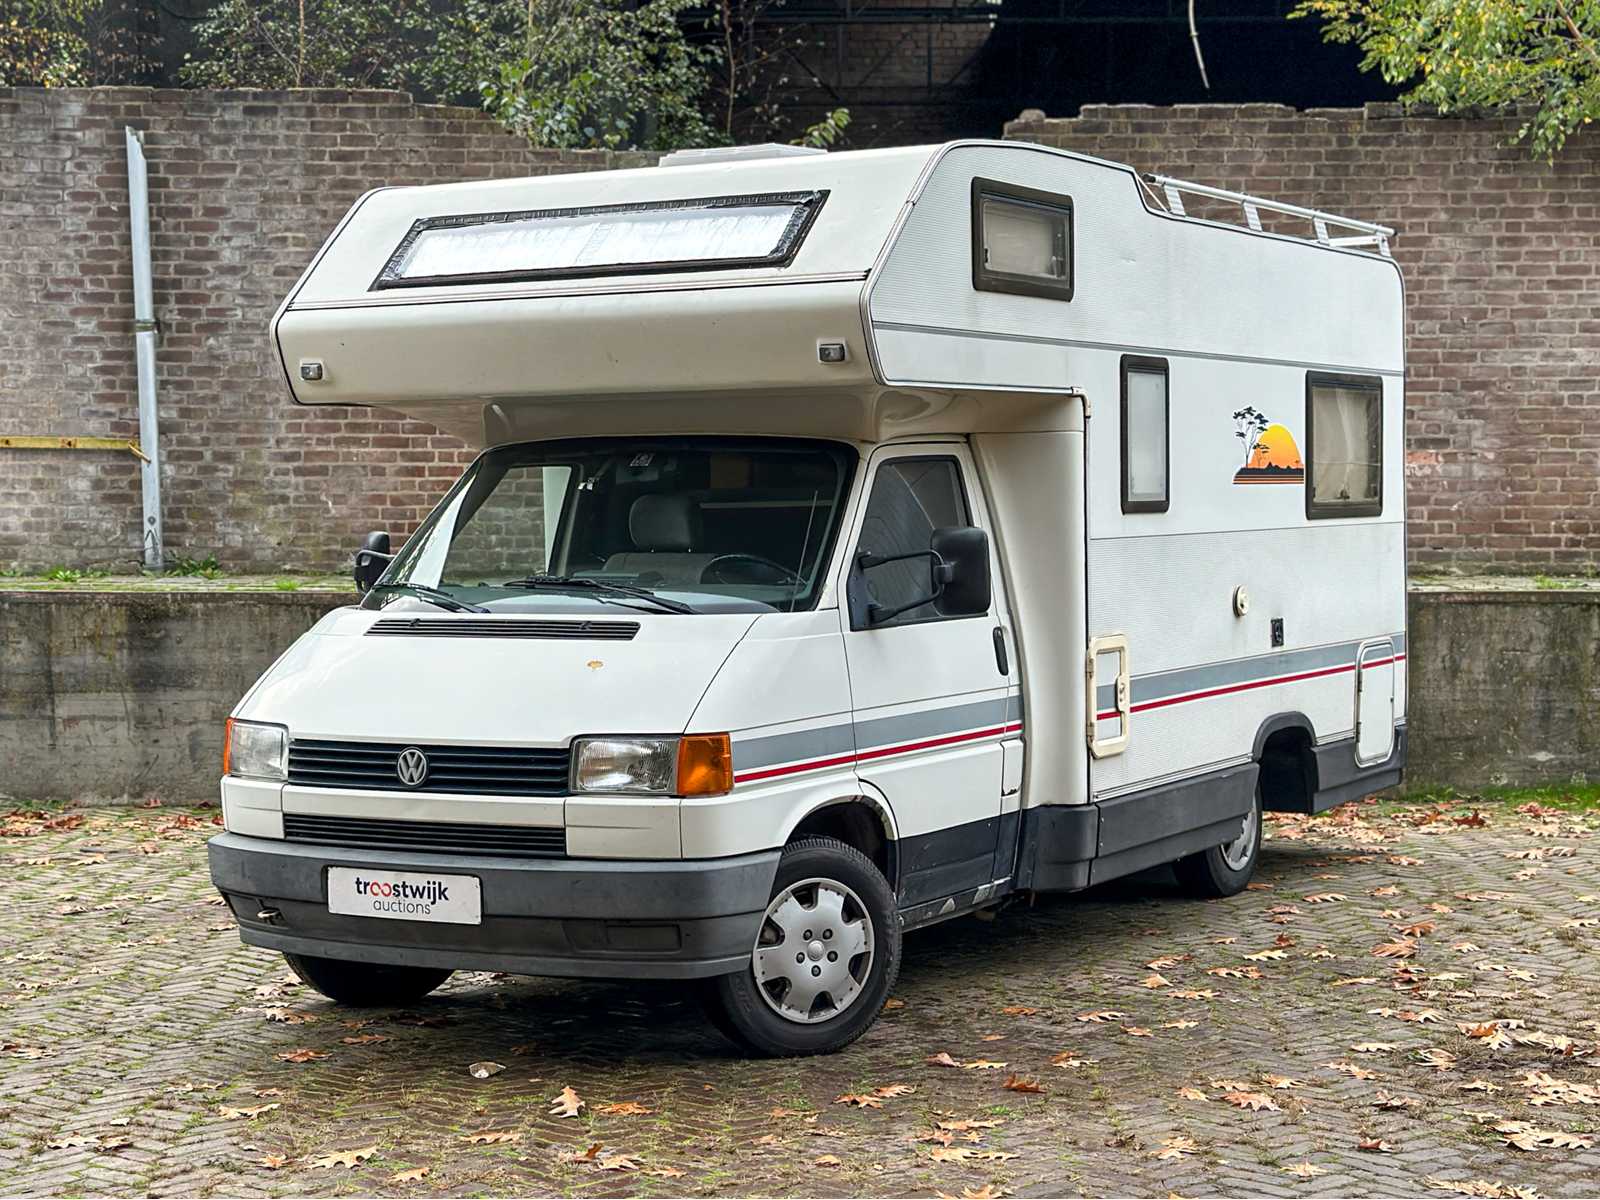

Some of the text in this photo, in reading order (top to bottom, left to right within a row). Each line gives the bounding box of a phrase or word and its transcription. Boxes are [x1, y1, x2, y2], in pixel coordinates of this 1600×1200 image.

[398, 750, 426, 785] VW
[355, 877, 449, 905] troostwijk
[373, 900, 431, 915] auctions
